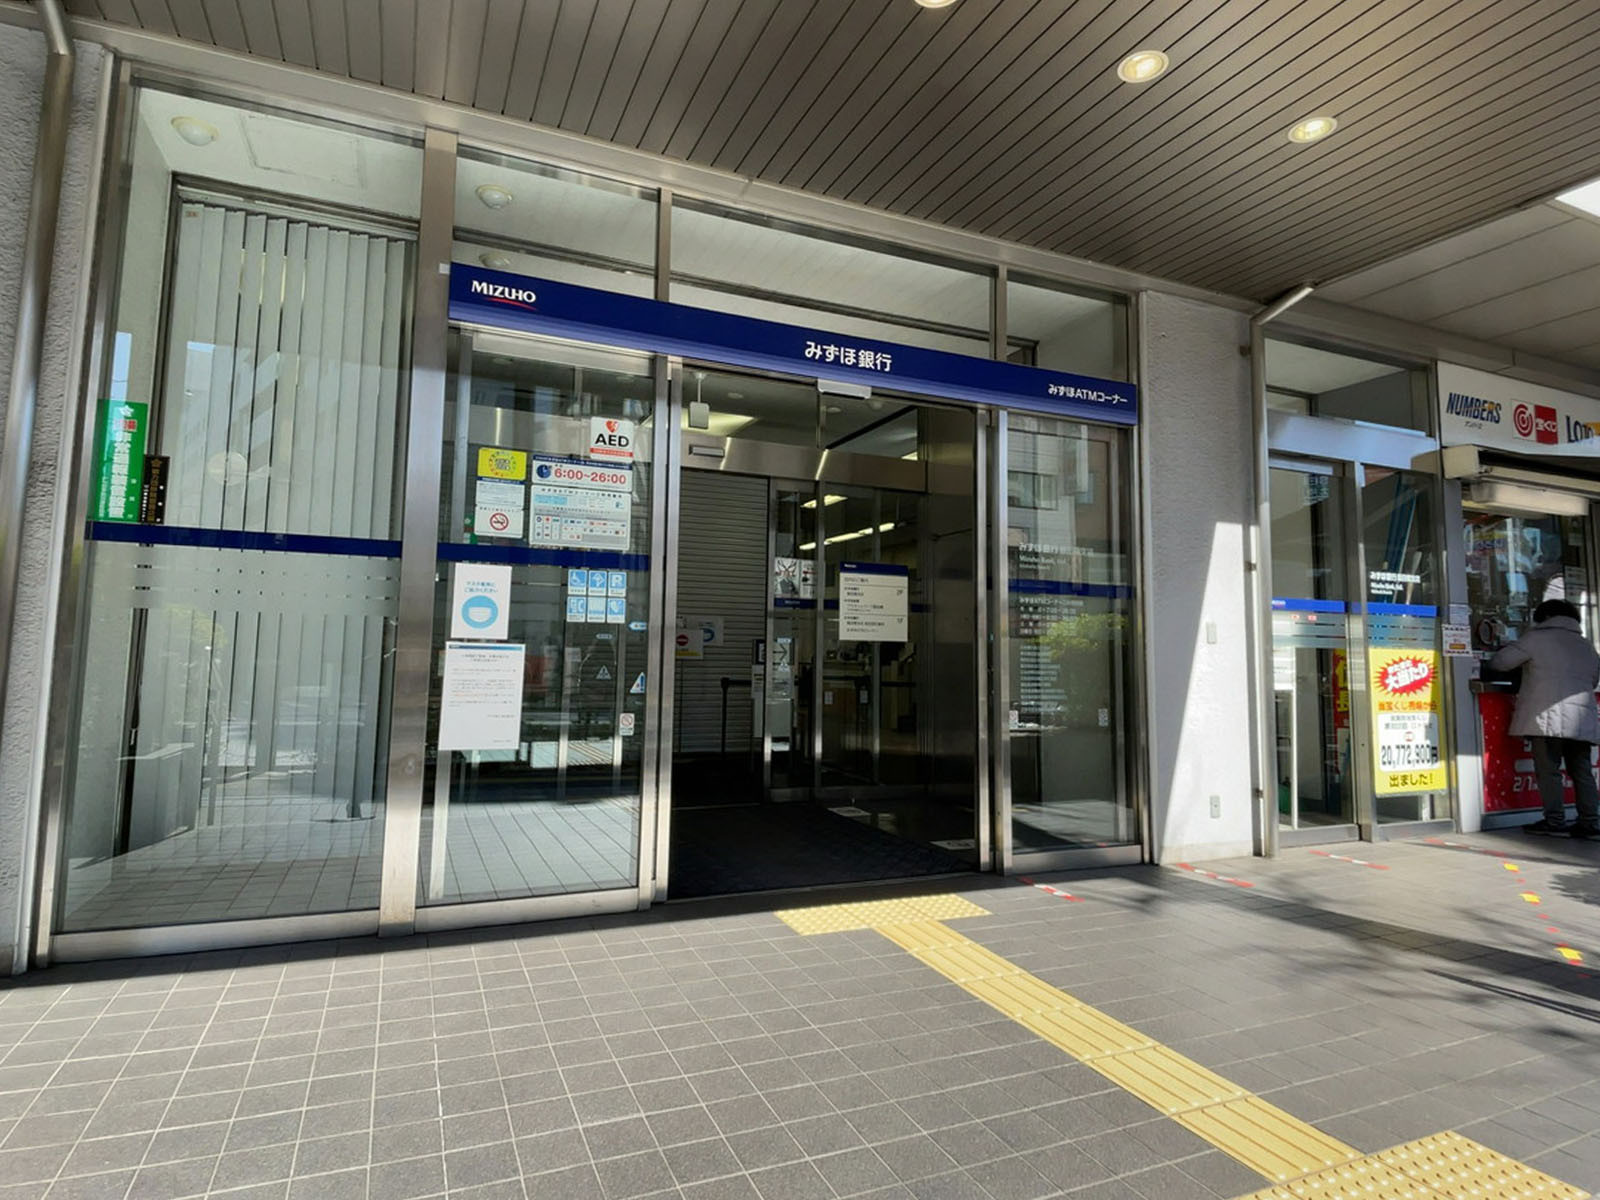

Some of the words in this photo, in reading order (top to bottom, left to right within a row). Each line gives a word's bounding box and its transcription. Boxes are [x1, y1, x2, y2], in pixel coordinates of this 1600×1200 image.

[471, 280, 537, 304] MIZUHO
[803, 341, 893, 373] みずほ銀行
[1048, 384, 1128, 406] みずほATMコーナー
[1446, 392, 1502, 424] NUMBERS
[594, 433, 630, 448] AED
